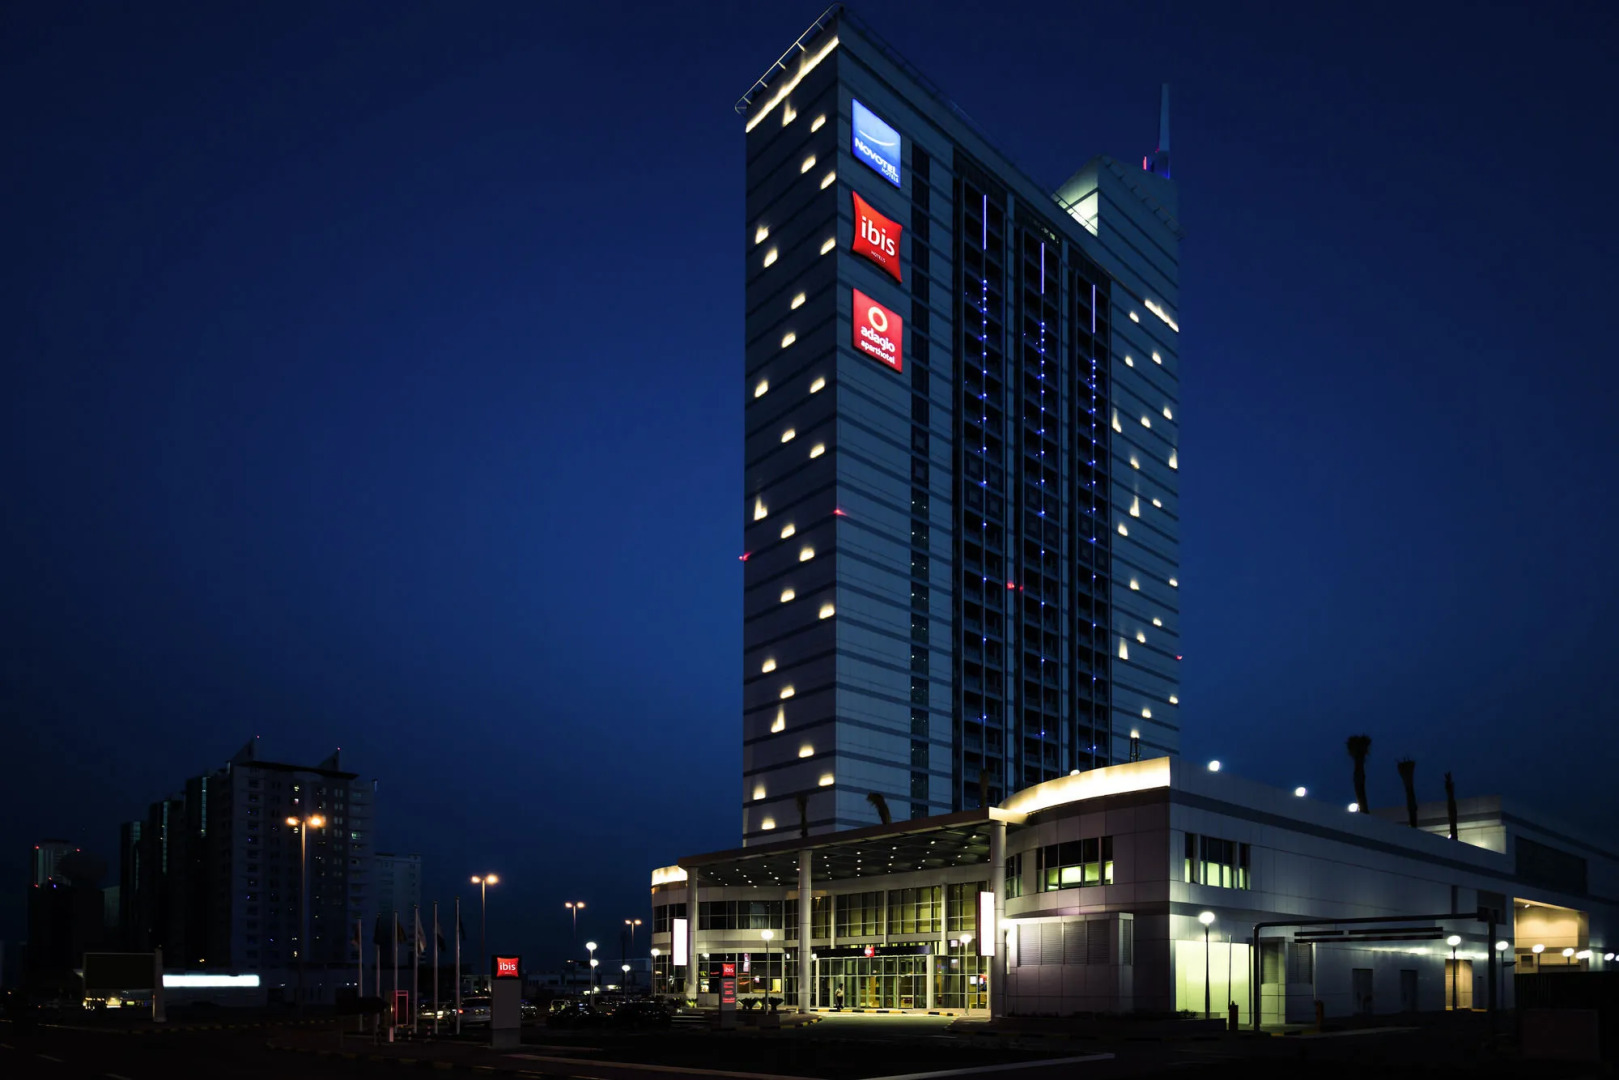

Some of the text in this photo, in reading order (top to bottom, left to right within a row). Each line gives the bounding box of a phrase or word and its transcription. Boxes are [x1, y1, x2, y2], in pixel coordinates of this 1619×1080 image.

[854, 137, 899, 178] NOVOTEL
[861, 215, 896, 256] ibis
[860, 326, 896, 353] adagio
[860, 340, 896, 364] aparthotel
[500, 962, 516, 970] ibis
